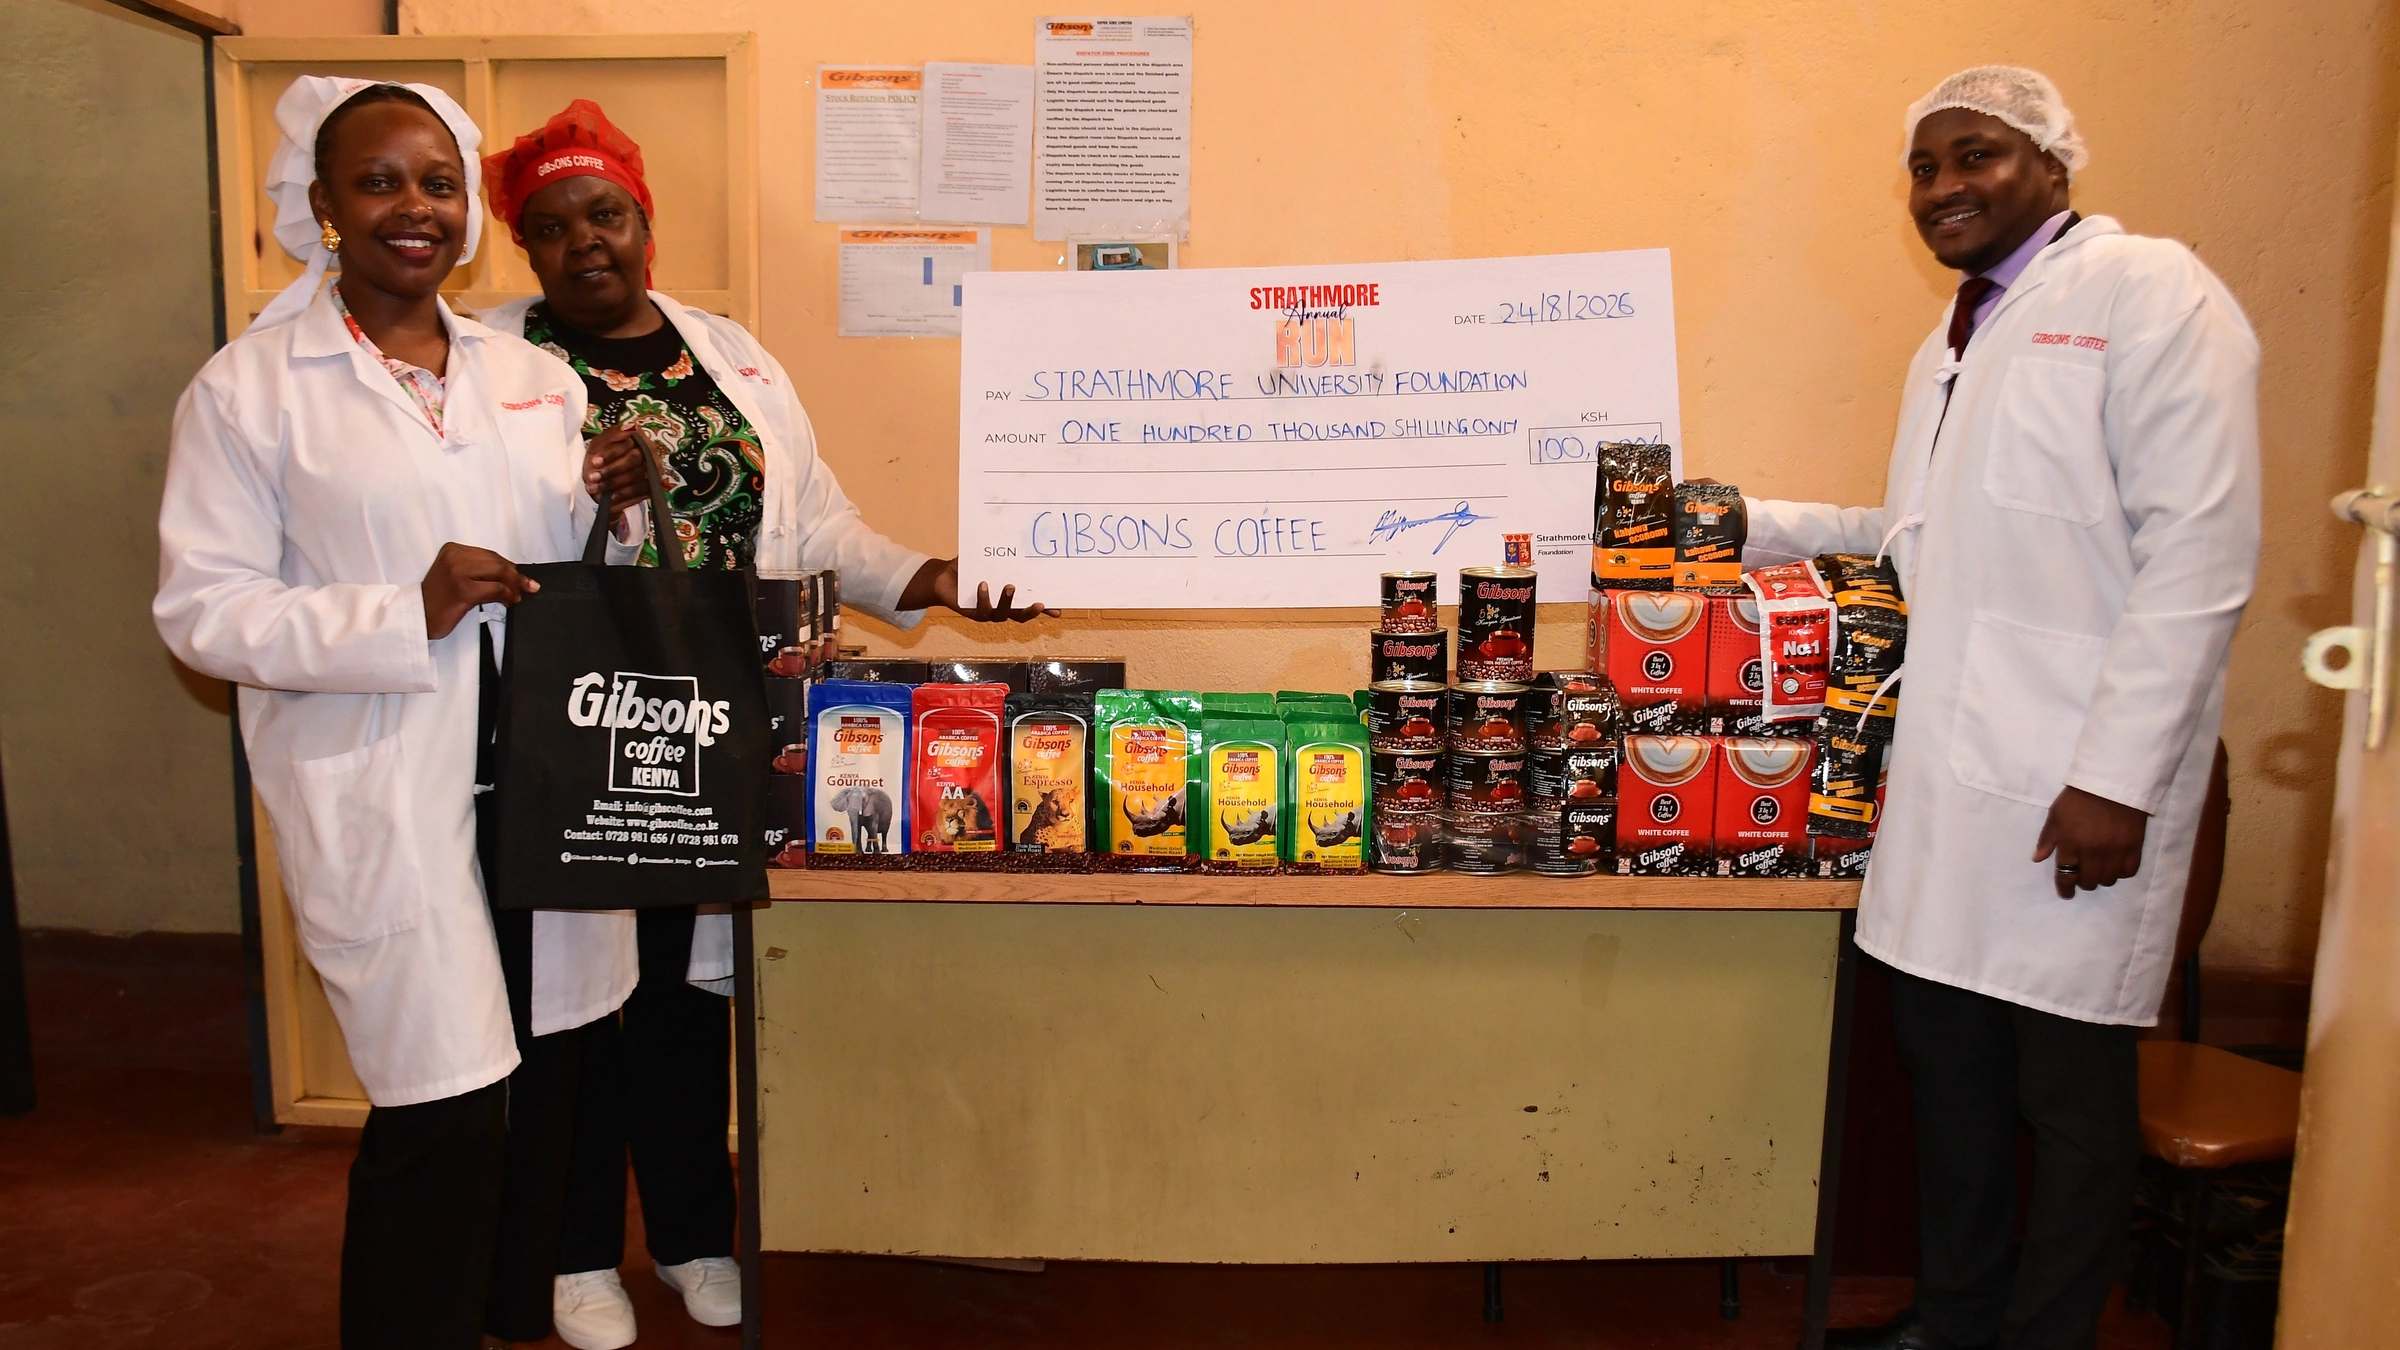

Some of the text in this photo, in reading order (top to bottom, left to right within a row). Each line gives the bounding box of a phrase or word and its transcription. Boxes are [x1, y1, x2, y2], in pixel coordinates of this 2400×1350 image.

[1046, 22, 1094, 31] Gibsons
[829, 72, 911, 83] Gibsons
[538, 155, 605, 177] GIBSONS COFFEE
[851, 231, 962, 240] Gibsons
[1250, 283, 1380, 310] STRATHMORE
[1282, 299, 1348, 327] Annual
[1454, 290, 1635, 326] DATE 24/8/2026
[1275, 318, 1355, 368] RUN
[2032, 332, 2108, 352] GIBSONS COFFEE
[985, 369, 1527, 401] PAY STRATHMORE UNIVERSITY FOUNDATION
[1580, 412, 1608, 422] KSH
[984, 418, 1517, 444] AMOUNT ONE HUNDRED THOUSAND SHILLING ONLY
[1613, 479, 1660, 494] Gibsons
[1628, 492, 1647, 500] coffee
[1685, 501, 1729, 516] Gibsons
[984, 546, 1017, 557] SIGN
[1032, 511, 1193, 558] GIBSONS
[1215, 517, 1326, 556] COFFEE
[1536, 533, 1586, 542] Strathmore
[1614, 524, 1648, 539] kahawa
[1628, 526, 1668, 544] economy
[1684, 544, 1717, 557] kahawa
[1698, 547, 1735, 562] economy
[1396, 580, 1429, 592] Gibsons
[1477, 582, 1532, 603] Gibsons
[1383, 640, 1438, 660] Gibsons
[1650, 669, 1665, 677] Coffee
[567, 671, 730, 746] Gibsons
[1399, 696, 1436, 709] Gibsons
[1477, 696, 1516, 710] Gibsons
[1567, 700, 1607, 713] Gibsons
[1633, 700, 1678, 724] Gibsons
[1650, 714, 1672, 728] coffee
[834, 729, 884, 746] Gibsons
[1023, 736, 1071, 751] Gibsons
[624, 735, 686, 766] coffee
[847, 743, 872, 753] coffee
[927, 741, 984, 760] Gibsons
[1037, 749, 1061, 760] coffee
[1125, 742, 1168, 757] Gibsons
[945, 757, 970, 767] coffee
[1137, 754, 1159, 763] coffee
[1396, 757, 1434, 770] Gibsons
[1489, 759, 1523, 772] Gibsons
[1569, 755, 1609, 769] Gibsons
[1222, 763, 1261, 775] Gibsons
[1309, 764, 1347, 777] Gibsons
[631, 767, 680, 789] KENYA
[827, 776, 884, 787] Gourmet
[1024, 776, 1073, 789] Espresso
[1233, 773, 1253, 781] coffee
[1320, 774, 1339, 783] coffee
[941, 787, 965, 800] AA
[1120, 783, 1175, 792] Household
[593, 799, 713, 816] Email: info@gibscoffee.com
[1305, 800, 1354, 808] Household
[586, 815, 625, 827] Website:
[1569, 811, 1609, 825] Gibsons
[1757, 813, 1773, 821] Coffee
[564, 829, 739, 845] Contact: 0728 981 656 / 0728 981 678
[1639, 842, 1685, 866] Gibsons
[1739, 844, 1785, 867] Gibsons
[1656, 856, 1678, 869] coffee
[1755, 858, 1778, 871] coffee
